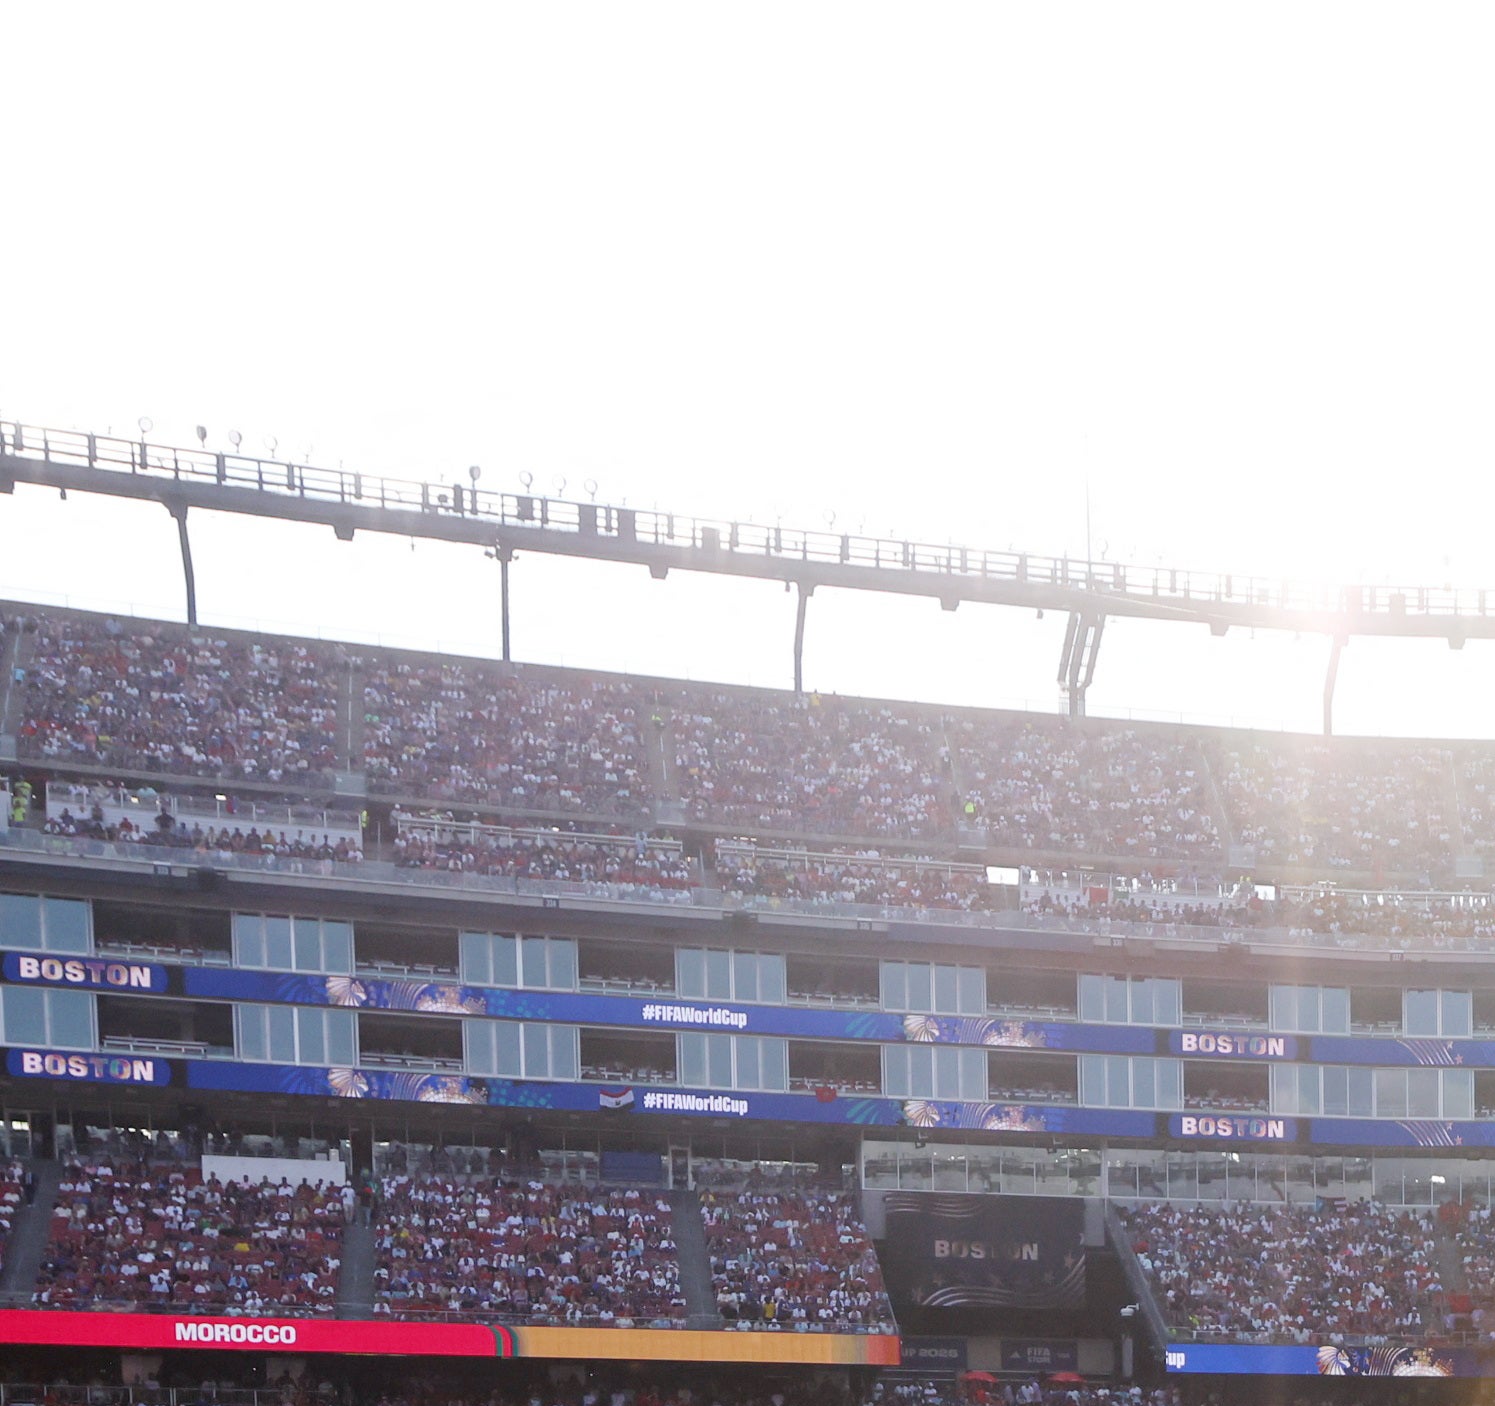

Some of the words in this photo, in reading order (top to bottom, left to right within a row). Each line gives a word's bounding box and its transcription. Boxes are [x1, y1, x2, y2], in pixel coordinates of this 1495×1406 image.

[19, 957, 151, 988] BOSTON
[642, 1004, 748, 1029] #FIFAWorldCup
[1182, 1033, 1284, 1057] BOSTON
[22, 1052, 154, 1082] BOSTON
[643, 1092, 748, 1116] #FIFAWorldCup
[1182, 1117, 1284, 1139] BOSTON
[175, 1322, 297, 1344] MOROCCO
[1165, 1350, 1186, 1369] up
